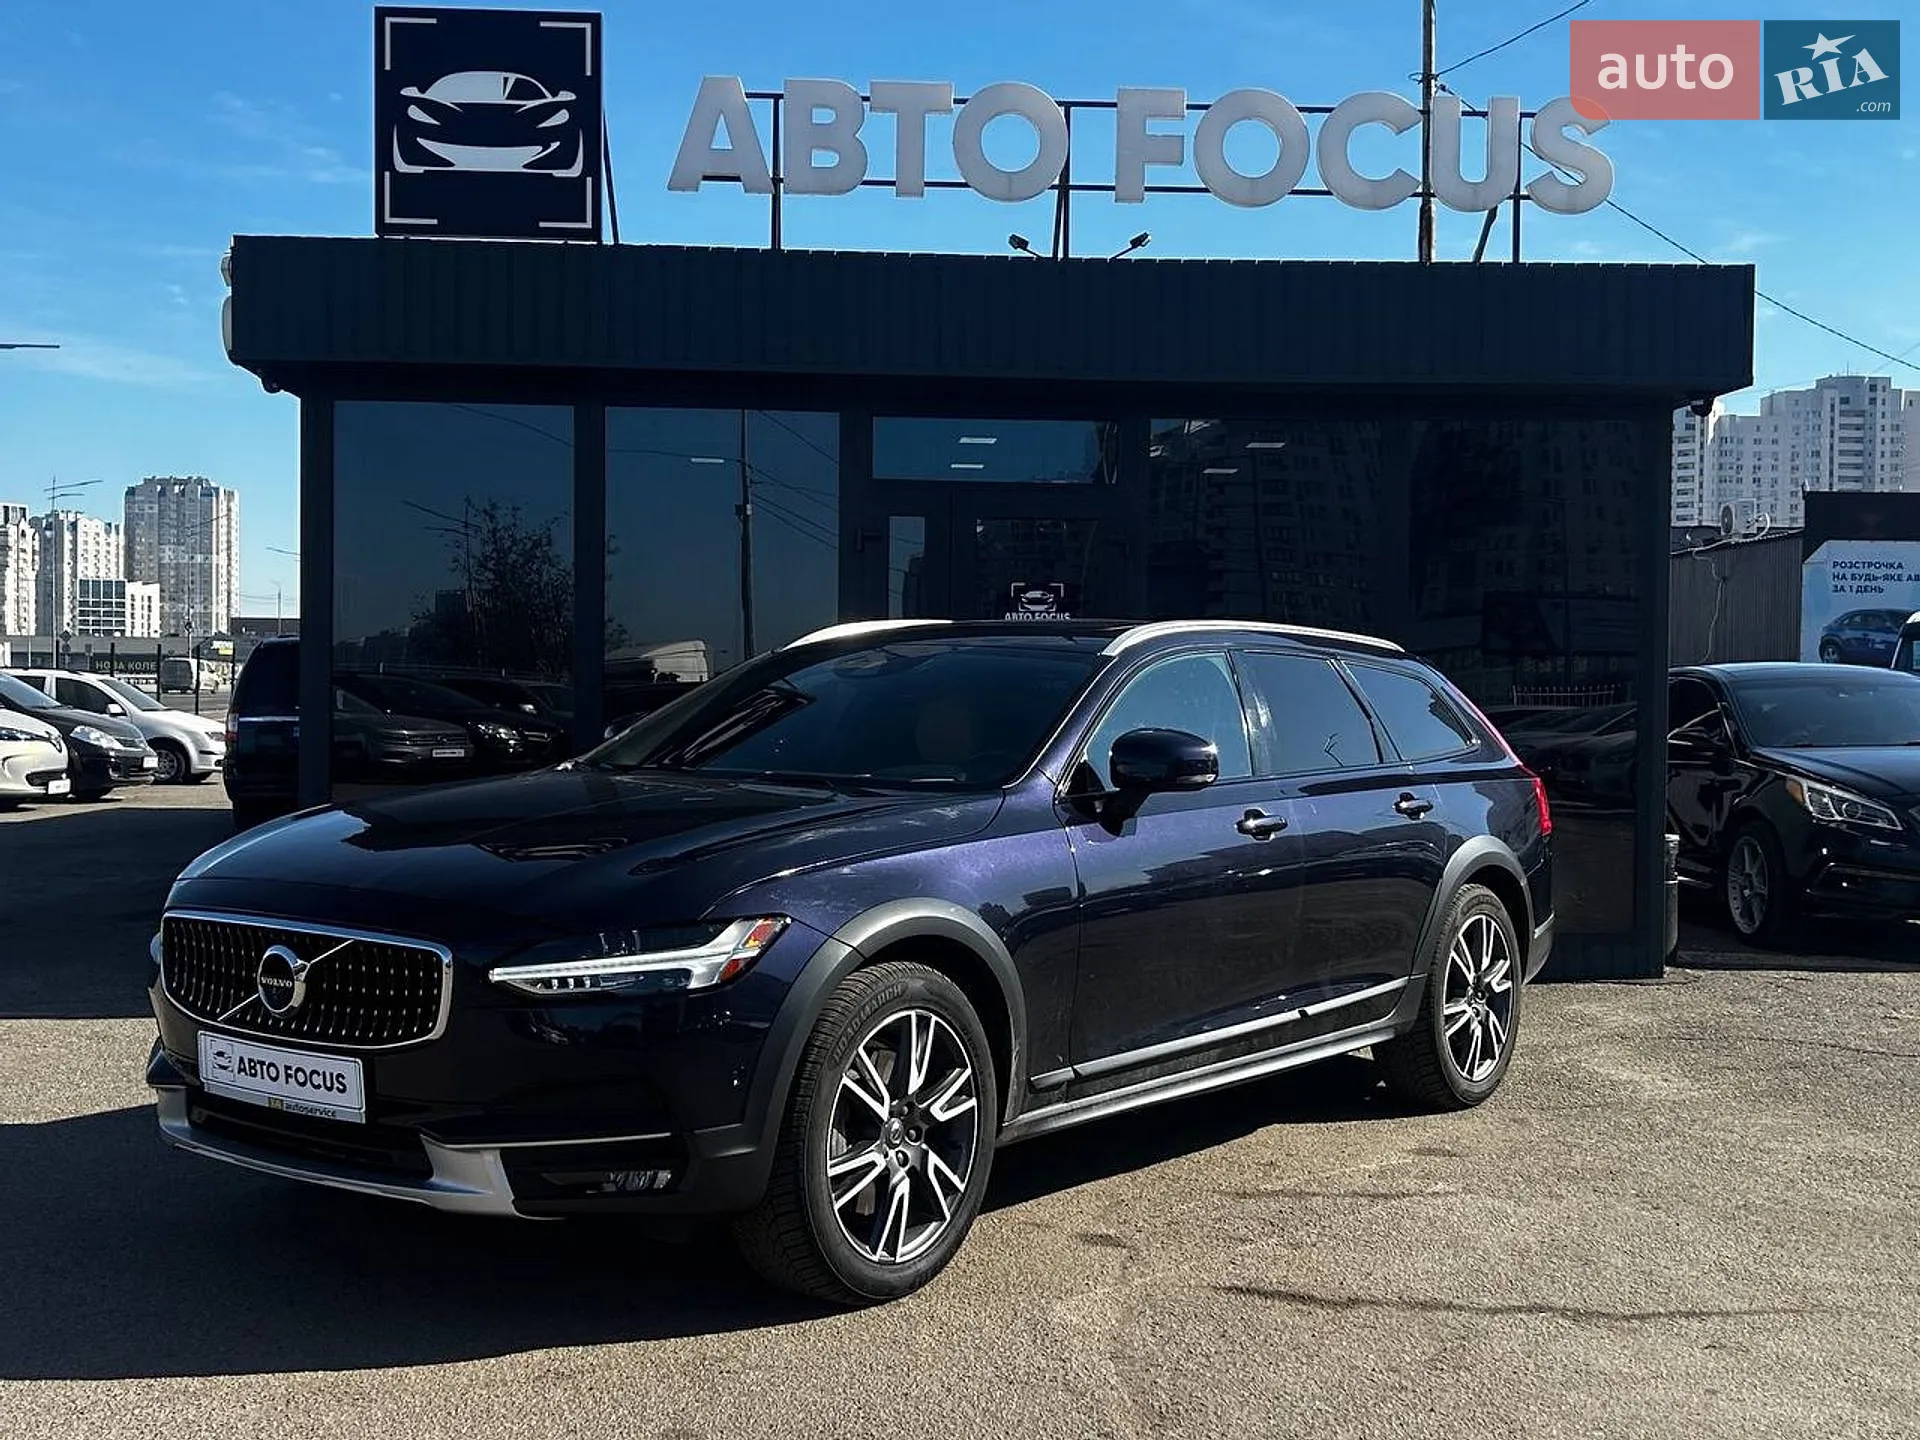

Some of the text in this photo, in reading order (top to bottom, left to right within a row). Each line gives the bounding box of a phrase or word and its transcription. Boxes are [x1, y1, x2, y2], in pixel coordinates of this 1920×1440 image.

[667, 74, 1616, 215] АВТО FOCUS
[1832, 561, 1904, 570] РОЗСТРОЧКА
[1832, 572, 1849, 581] НА
[1851, 573, 1904, 582] БУДЬ-ЯКЕ
[1832, 584, 1847, 593] ЗА
[1855, 585, 1885, 595] ДЕНЬ
[261, 976, 293, 987] VOLVO
[237, 1056, 347, 1094] АВТО FOCUS
